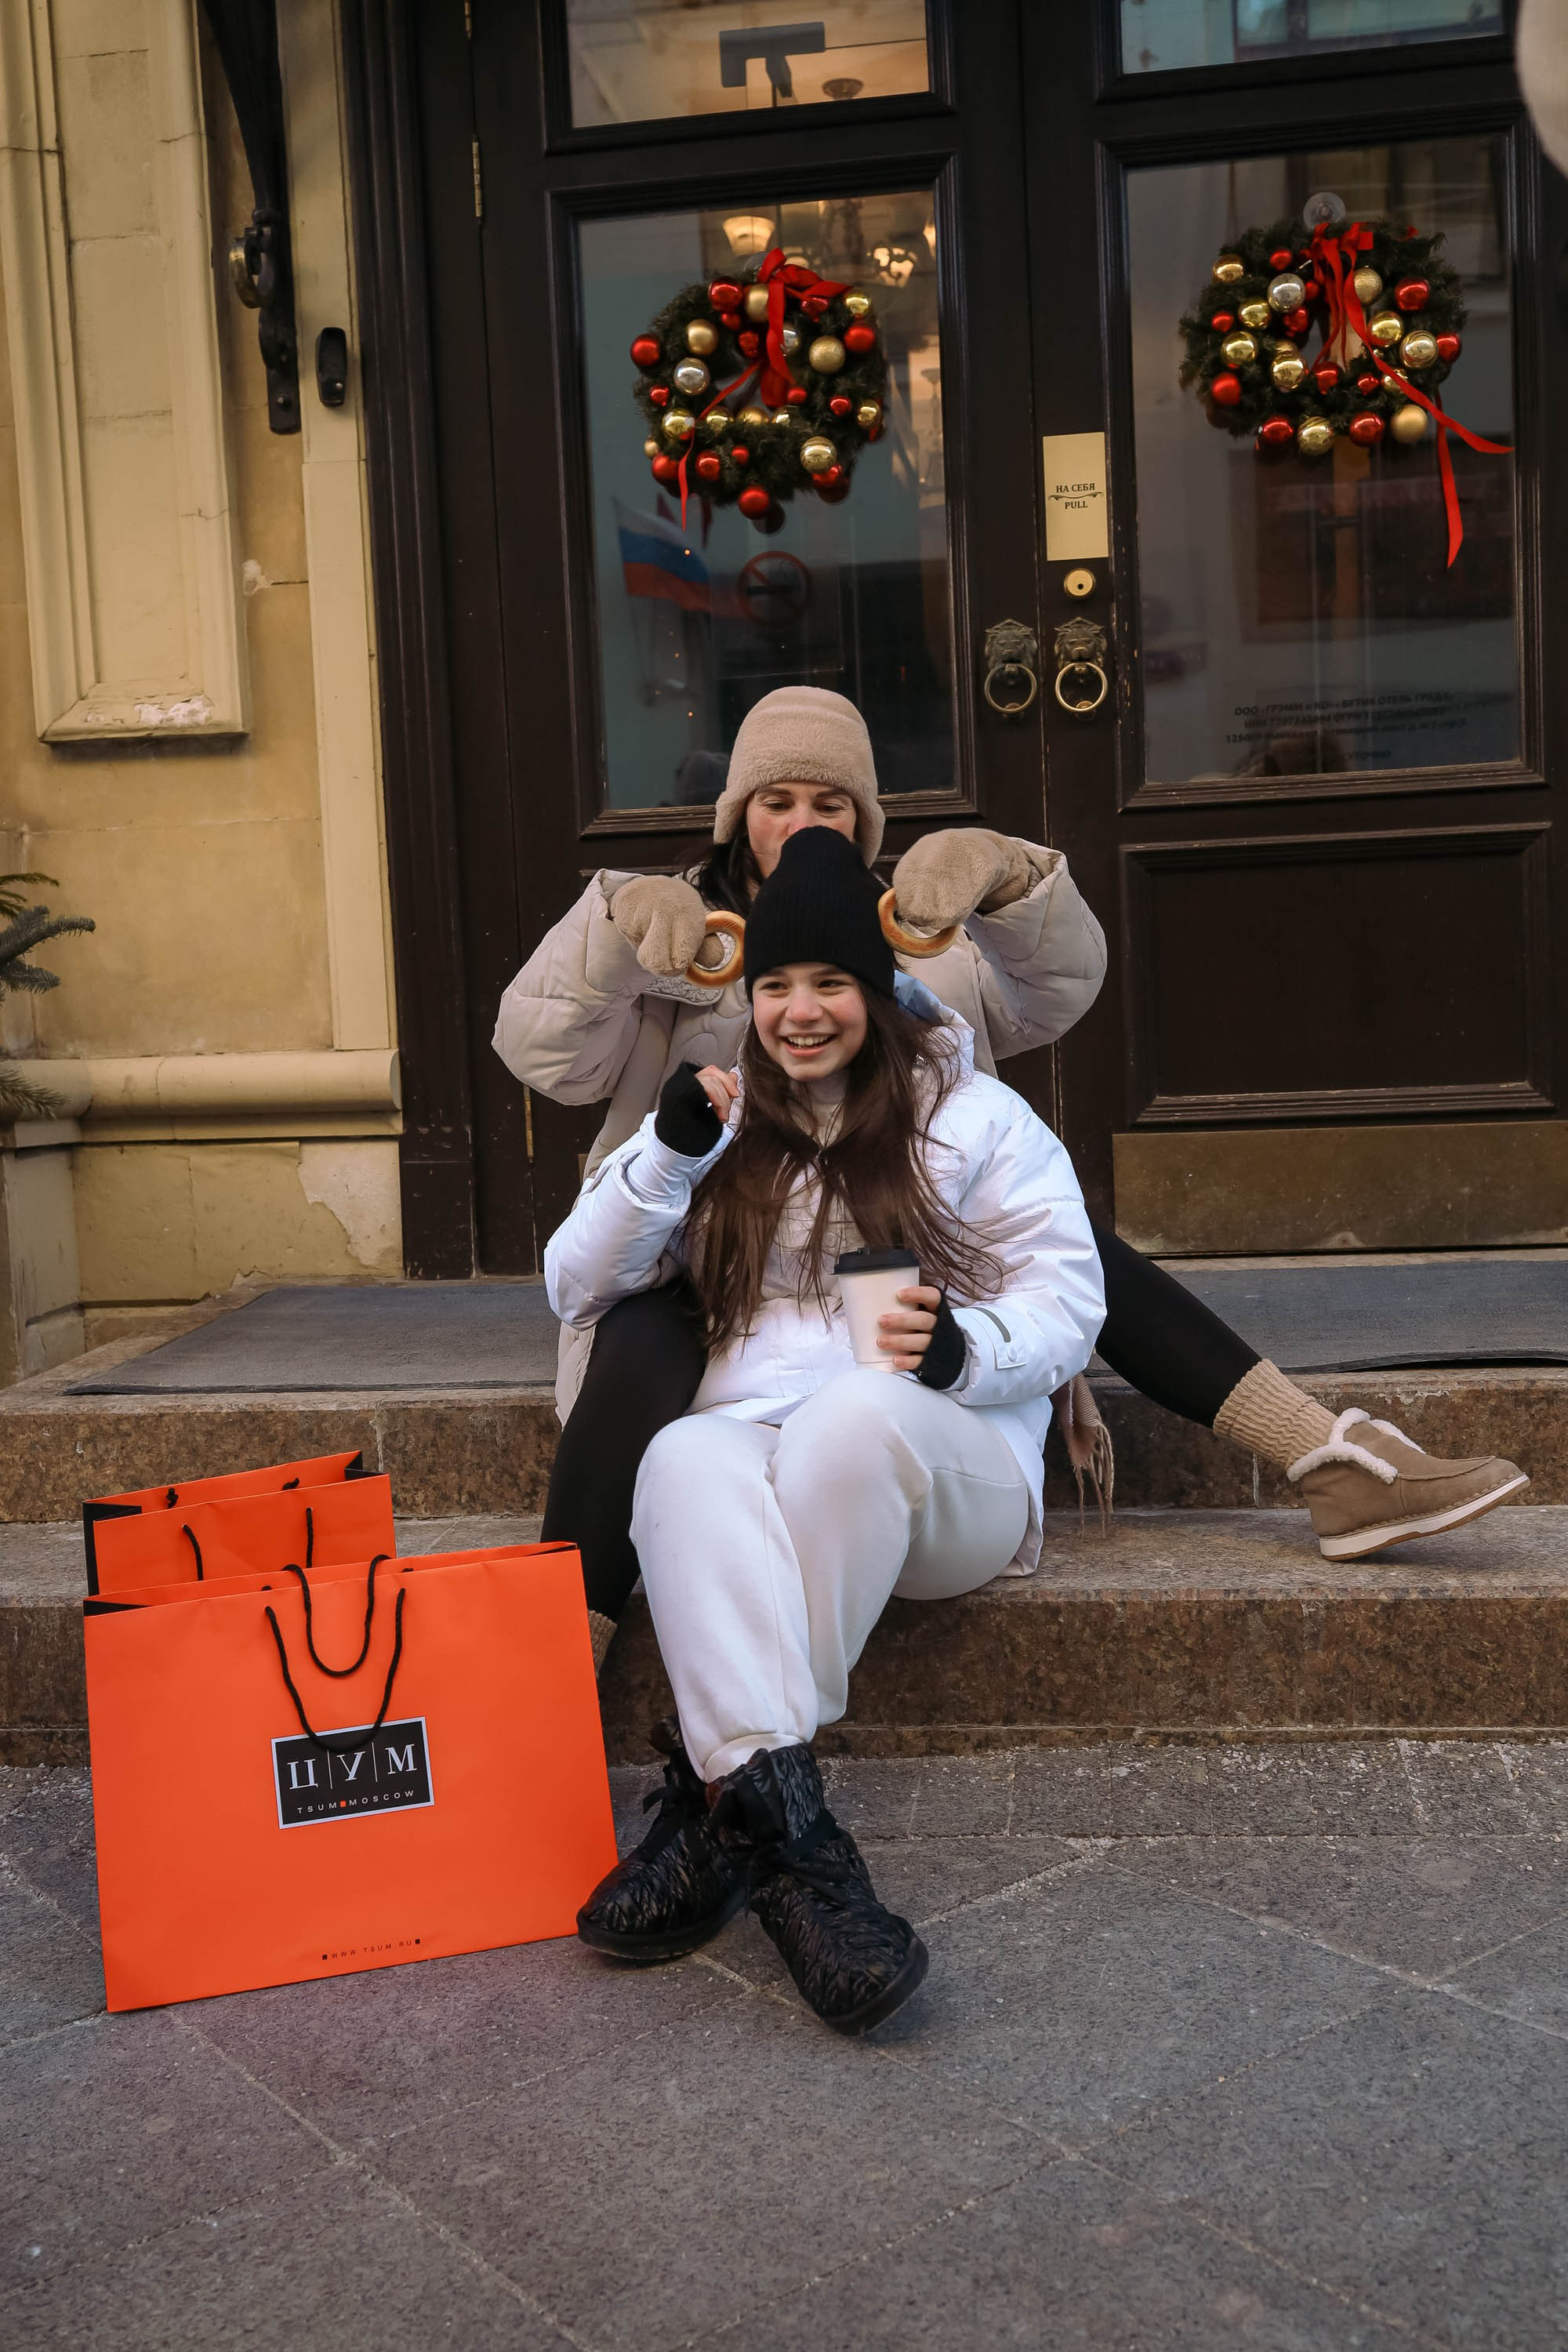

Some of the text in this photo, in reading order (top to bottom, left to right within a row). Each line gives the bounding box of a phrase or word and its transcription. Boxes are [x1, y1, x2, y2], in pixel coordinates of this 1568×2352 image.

[1056, 482, 1096, 493] НА СЕБЯ
[1065, 500, 1089, 510] PULL
[1234, 706, 1259, 716] ООО
[349, 1790, 415, 1806] MOSCOW
